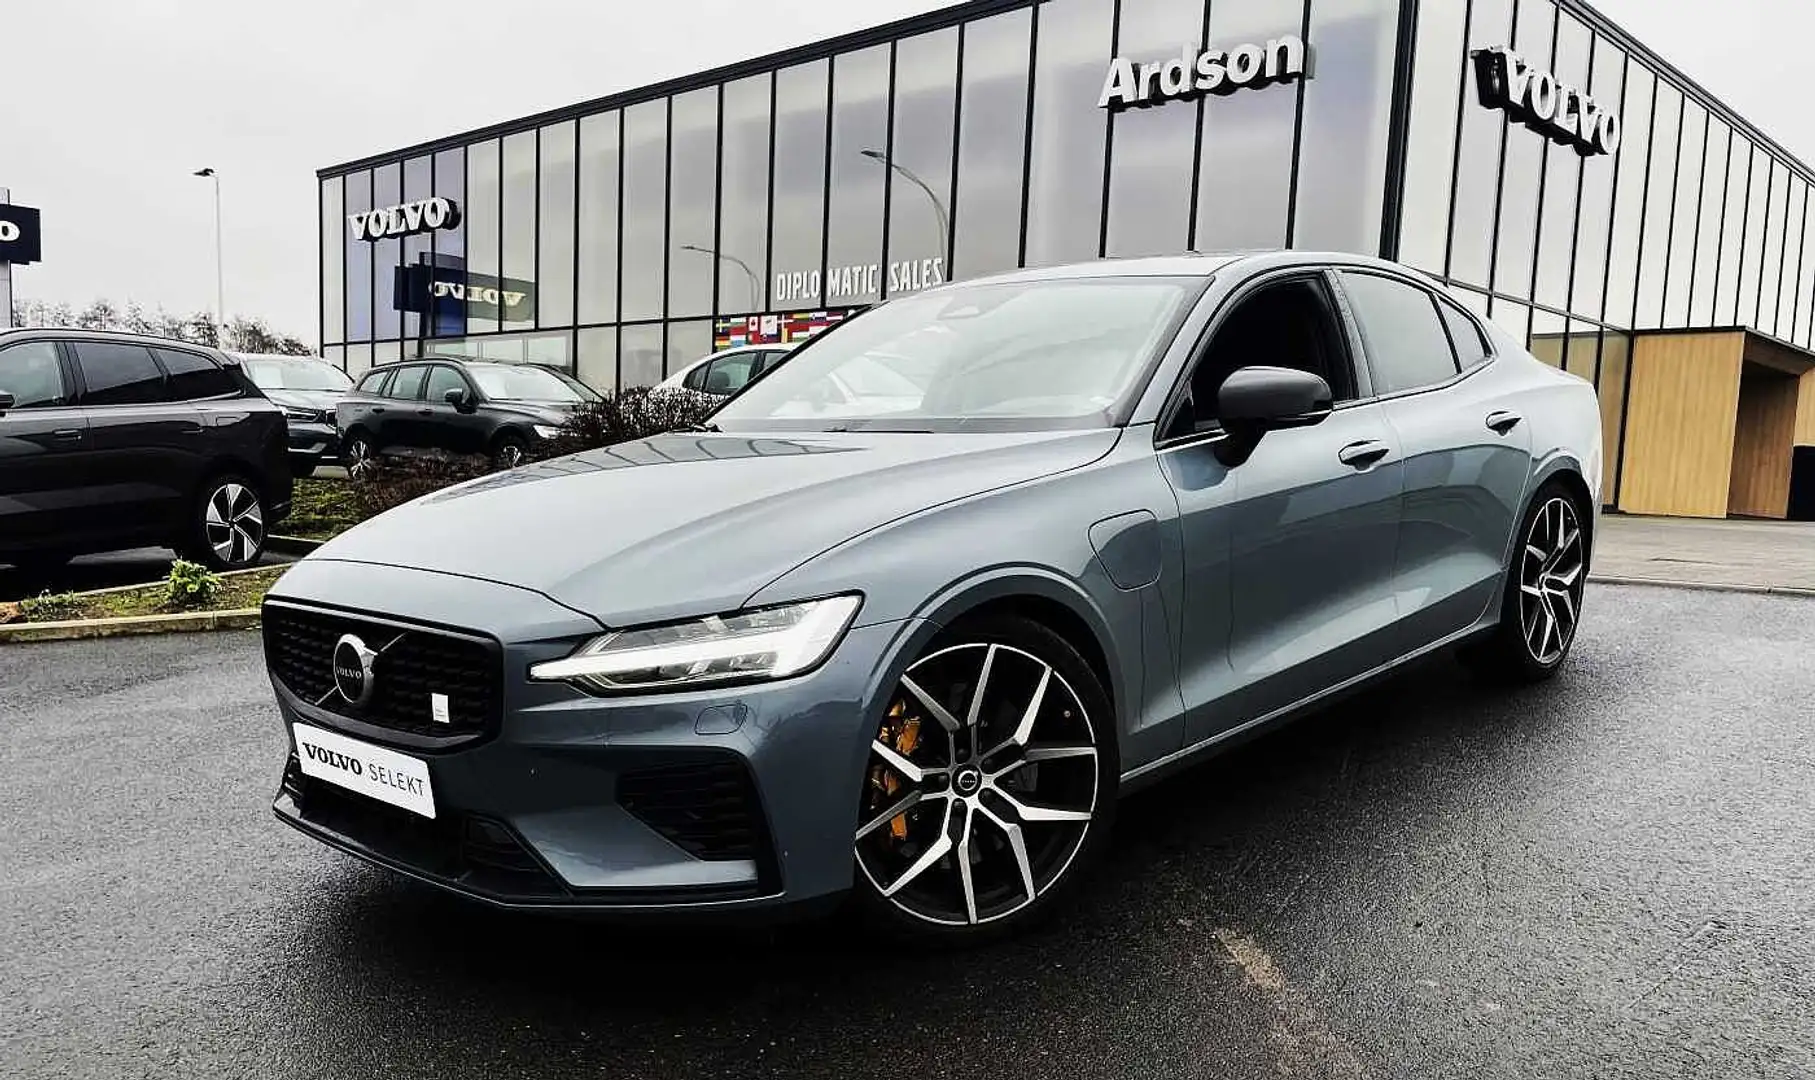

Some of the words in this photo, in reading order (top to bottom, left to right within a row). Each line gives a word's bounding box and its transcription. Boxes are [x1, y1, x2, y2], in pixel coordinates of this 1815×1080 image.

[1097, 34, 1304, 107] Ardson
[1502, 46, 1621, 156] VOLVO
[348, 197, 452, 241] VOLVO
[890, 257, 944, 292] SALES
[335, 665, 362, 680] VOLVO
[302, 742, 363, 776] VOLVO
[368, 763, 424, 797] SELEKT
